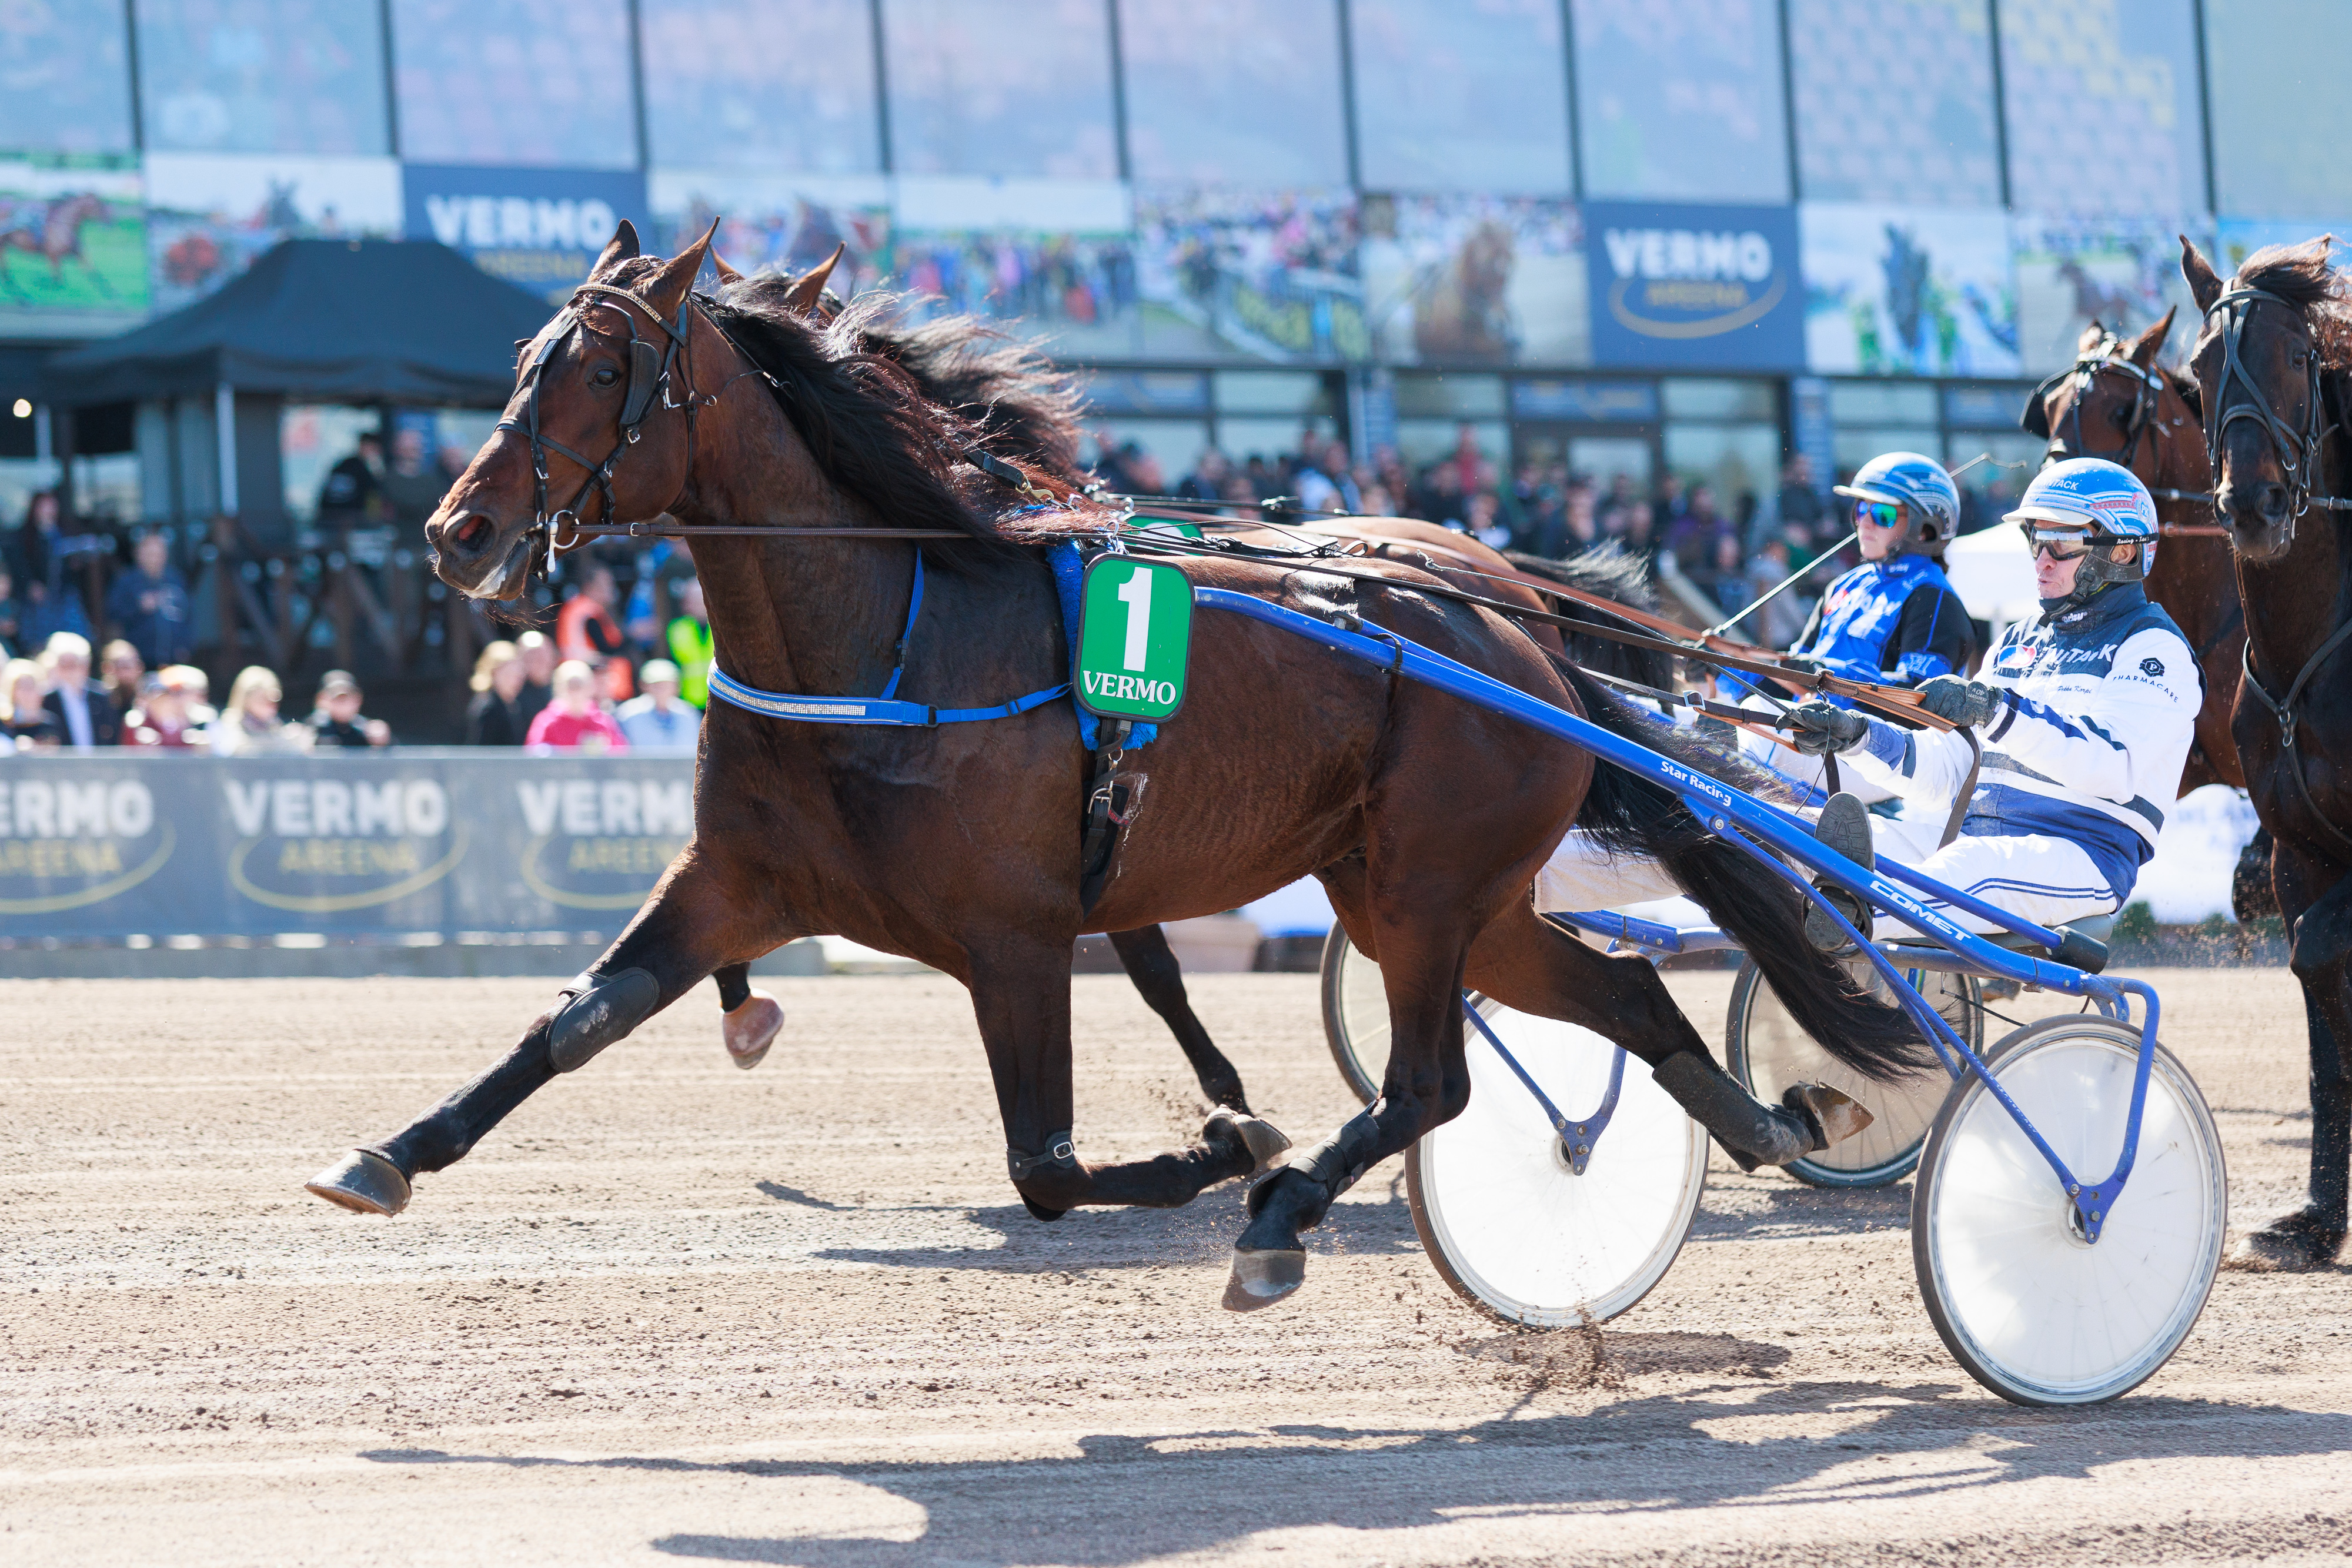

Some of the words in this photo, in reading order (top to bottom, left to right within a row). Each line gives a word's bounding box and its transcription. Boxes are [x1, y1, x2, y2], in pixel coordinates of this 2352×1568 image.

[425, 195, 615, 250] VERMO
[1603, 228, 1772, 282] VERMO
[1118, 566, 1152, 672] 1
[1083, 670, 1177, 705] VERMO
[223, 778, 449, 838] VERMO
[517, 778, 693, 837] VERM
[1661, 761, 1688, 781] Star
[1689, 774, 1732, 807] Racing
[1869, 880, 1972, 941] COMET
